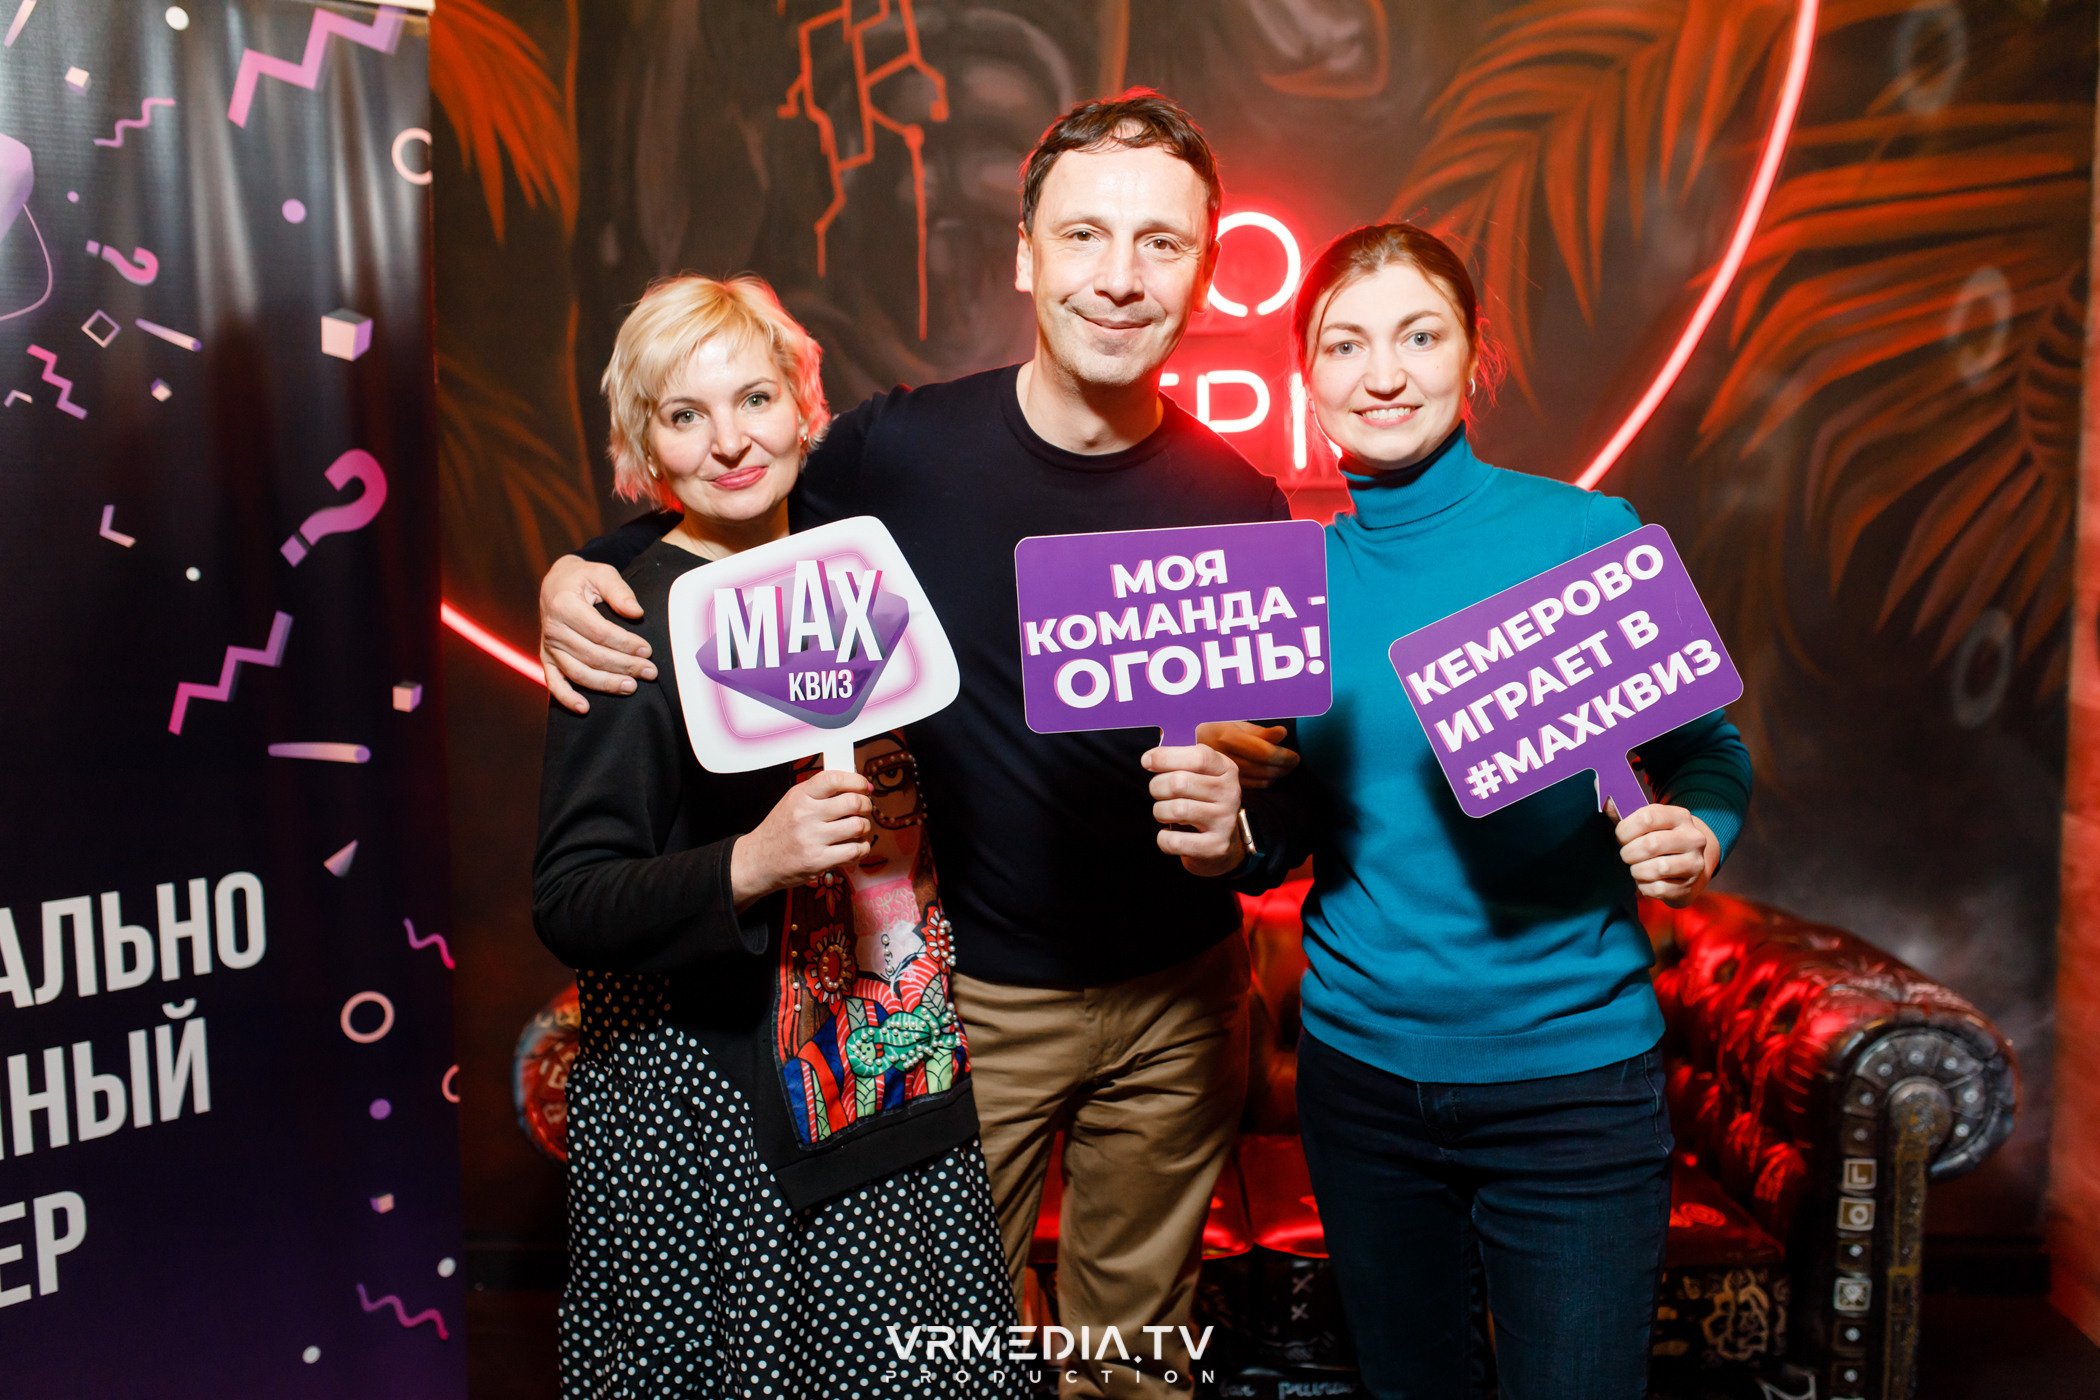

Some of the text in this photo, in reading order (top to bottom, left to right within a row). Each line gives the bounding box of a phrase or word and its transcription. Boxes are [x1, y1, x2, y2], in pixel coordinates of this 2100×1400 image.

[714, 559, 887, 671] MAX
[1023, 586, 1297, 656] КОМАНДА
[1110, 549, 1228, 599] МОЯ
[1406, 544, 1664, 705] КЕМЕРОВО
[788, 669, 854, 701] КВИЗ
[1054, 626, 1325, 709] ОГОНЬ!
[1434, 610, 1659, 753] ИГРАЕТ В
[1464, 638, 1721, 800] #МАХКВИЗ
[0, 998, 211, 1161] НЫЙ
